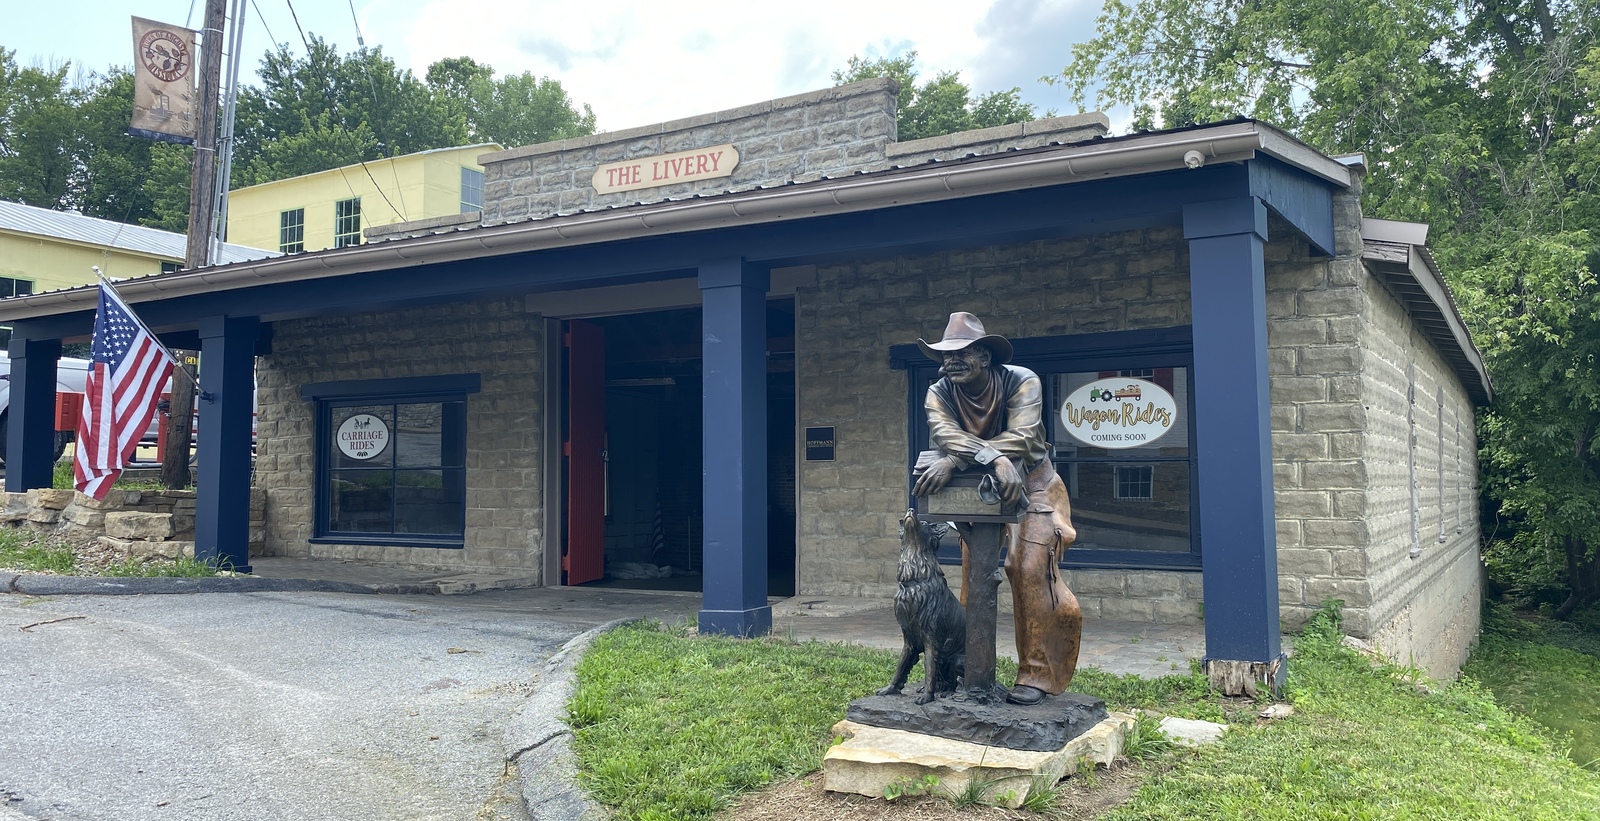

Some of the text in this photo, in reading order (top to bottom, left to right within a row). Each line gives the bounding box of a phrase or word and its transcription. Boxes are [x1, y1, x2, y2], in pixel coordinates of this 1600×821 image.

[605, 151, 724, 187] THE LIVERY
[1066, 401, 1171, 431] Wagon Rides
[341, 430, 384, 441] CARRIAGE
[1090, 433, 1147, 442] COMING SOON
[350, 440, 375, 450] RIDES
